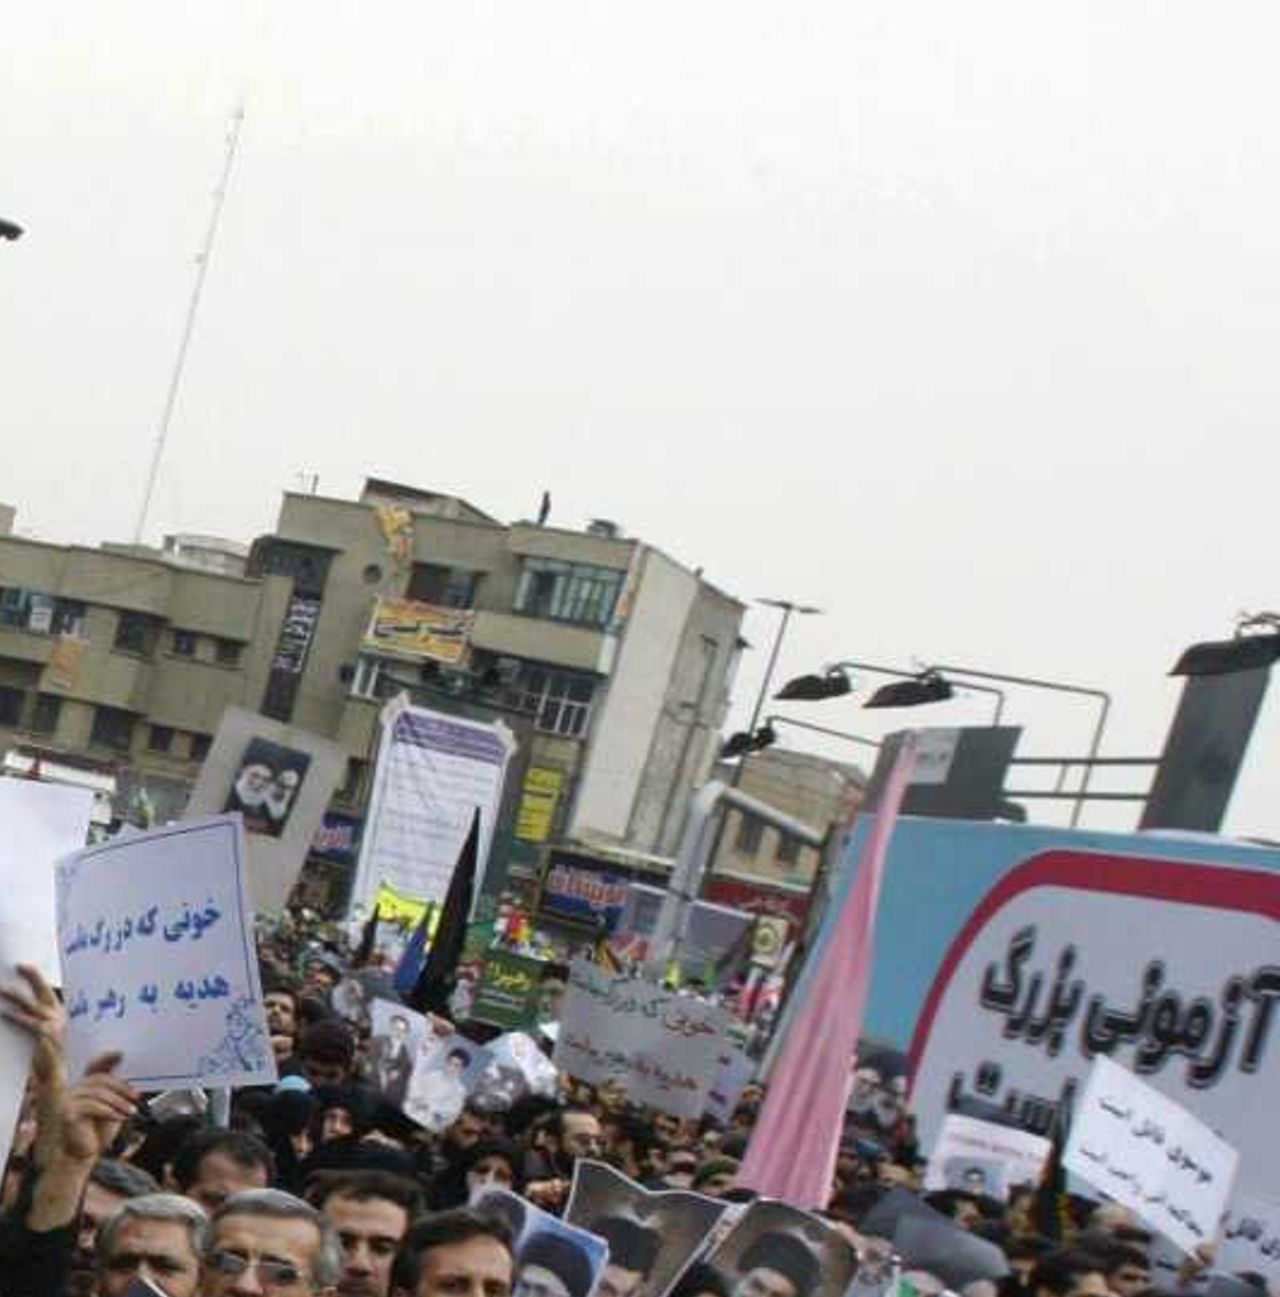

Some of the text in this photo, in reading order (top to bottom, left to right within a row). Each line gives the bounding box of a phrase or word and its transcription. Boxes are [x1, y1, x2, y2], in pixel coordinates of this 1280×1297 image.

[163, 896, 222, 943] خونی
[138, 981, 158, 1014] به
[173, 973, 231, 1011] هدیه
[980, 924, 1086, 1057] بزرگ
[1099, 1098, 1132, 1121] است
[1131, 1119, 1166, 1145] قاتل
